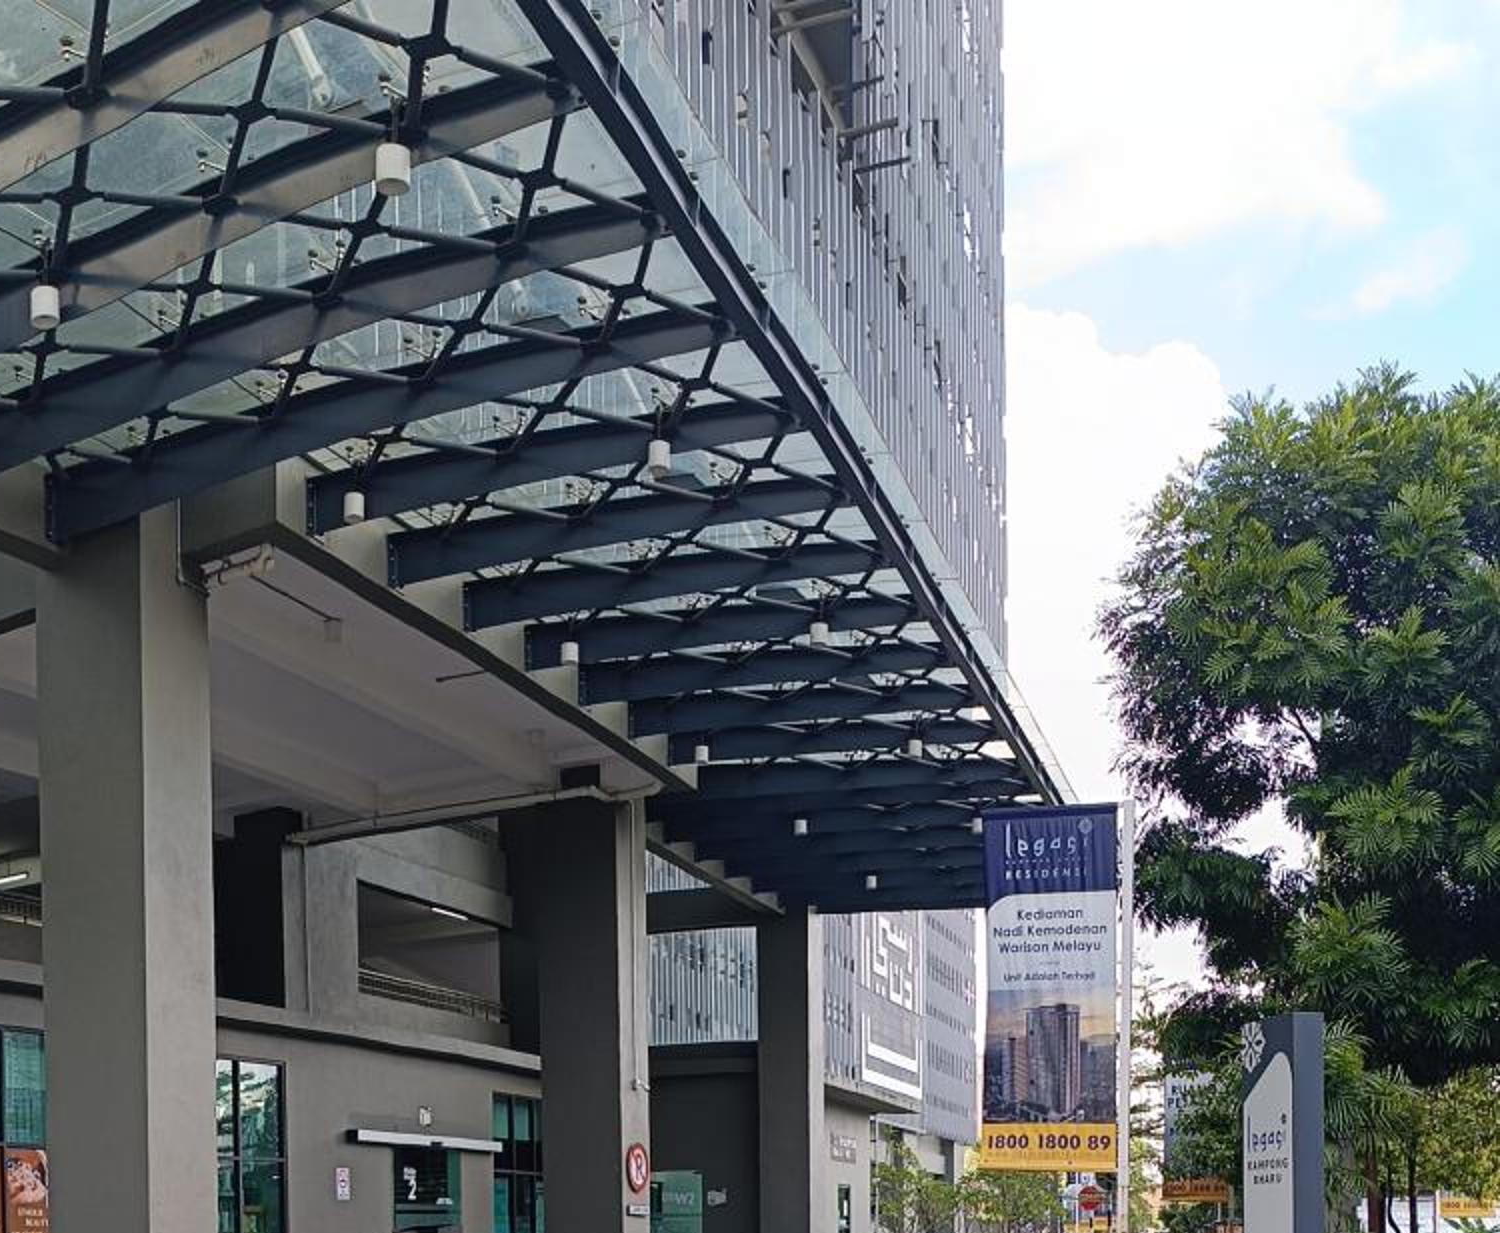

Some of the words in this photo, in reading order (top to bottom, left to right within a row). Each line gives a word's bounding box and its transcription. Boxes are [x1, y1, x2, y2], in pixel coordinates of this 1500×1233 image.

[1017, 908, 1083, 921] Kediaman
[993, 926, 1023, 938] Nadi
[1027, 924, 1107, 937] Kemodenan
[999, 941, 1049, 953] Warisan
[1052, 940, 1101, 953] Melayu
[988, 1135, 1029, 1149] 1800
[1039, 1134, 1081, 1149] 1800
[1087, 1135, 1111, 1151] 89
